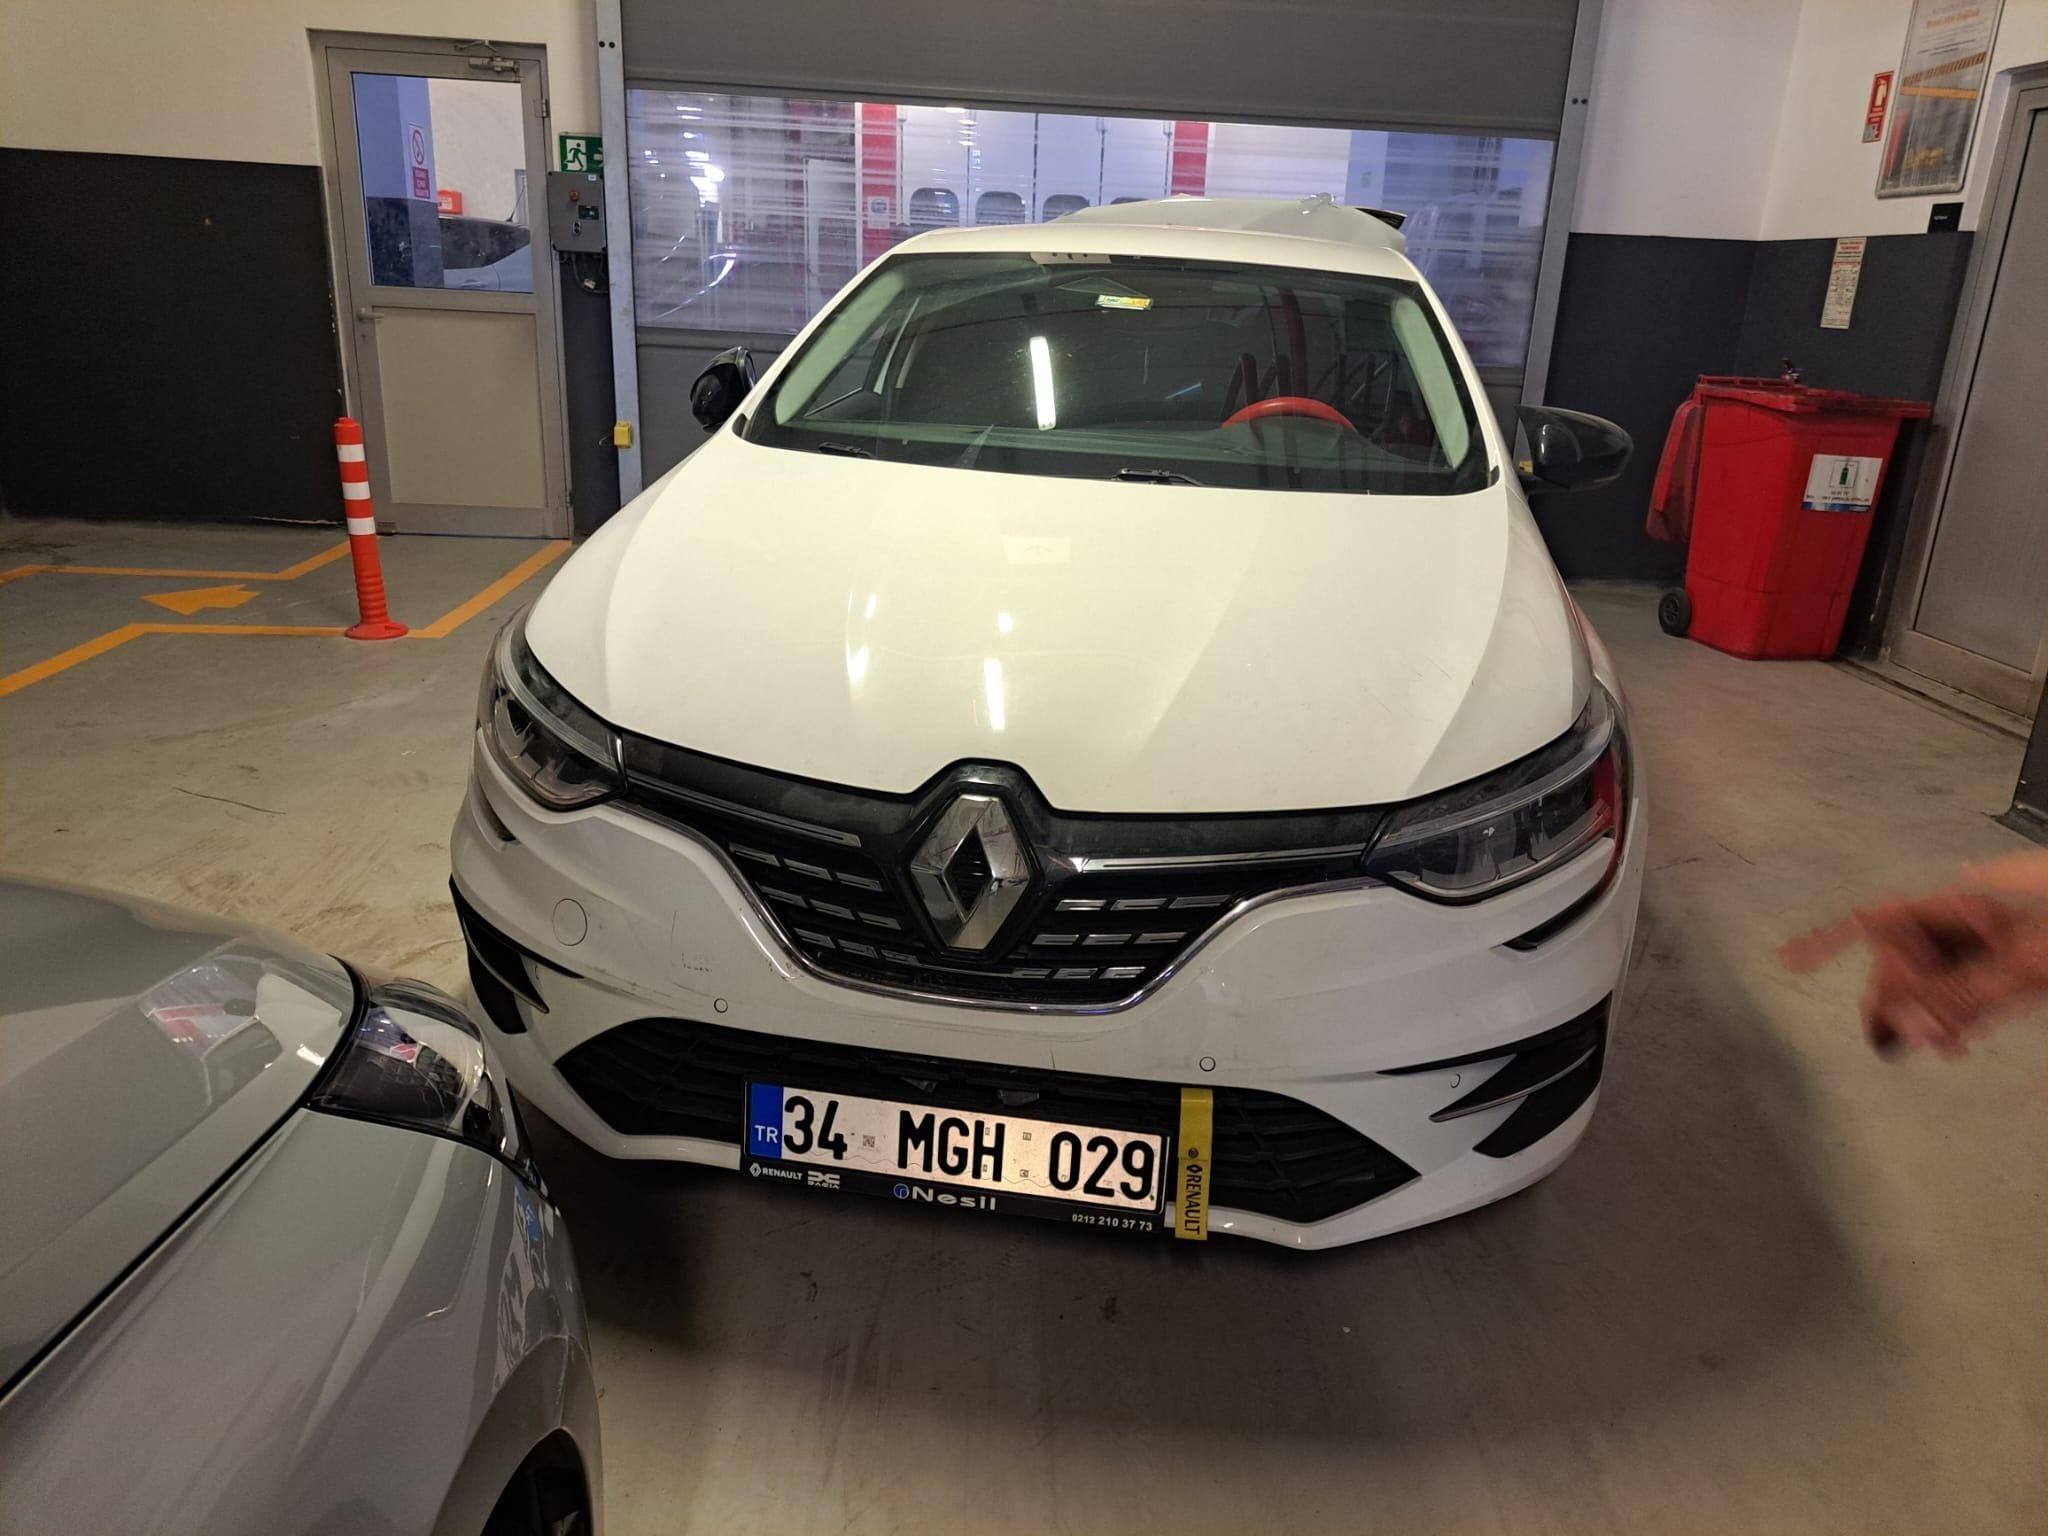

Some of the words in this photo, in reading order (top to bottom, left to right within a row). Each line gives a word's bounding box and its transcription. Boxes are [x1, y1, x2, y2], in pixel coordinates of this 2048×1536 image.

[755, 1125, 779, 1144] TR
[784, 1095, 848, 1160] 34
[898, 1110, 1006, 1182] MGH
[1048, 1131, 1155, 1200] 029
[762, 1167, 803, 1180] RENAULT
[912, 1186, 996, 1210] Nesil
[1184, 1174, 1203, 1235] RENAULT
[1072, 1214, 1096, 1224] 0212
[1098, 1216, 1119, 1227] 210
[1122, 1219, 1137, 1230] 37
[1140, 1221, 1153, 1232] 73
